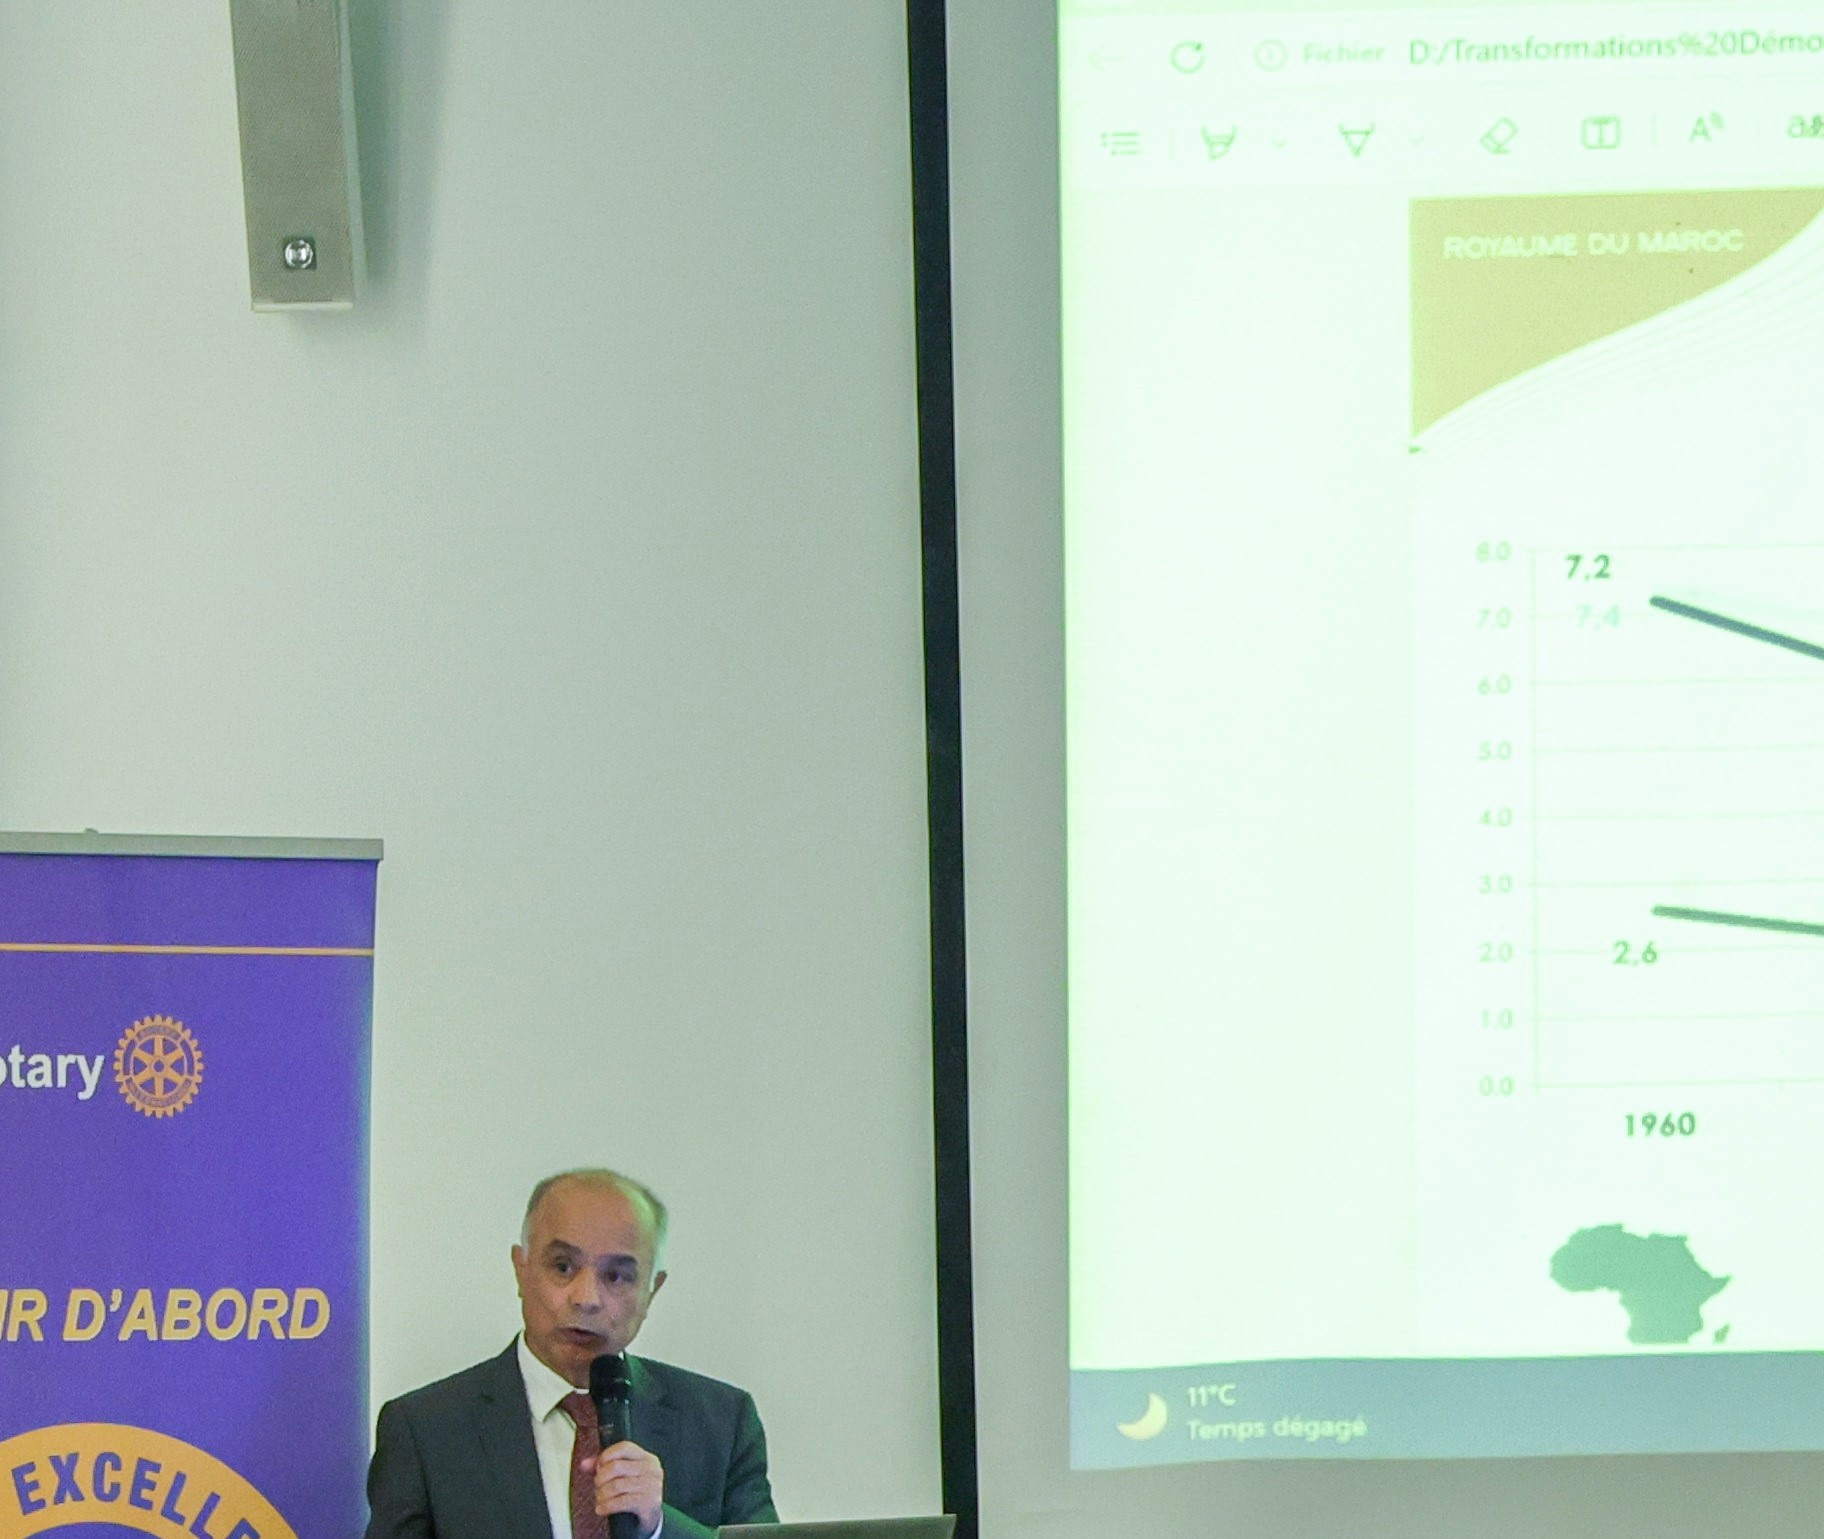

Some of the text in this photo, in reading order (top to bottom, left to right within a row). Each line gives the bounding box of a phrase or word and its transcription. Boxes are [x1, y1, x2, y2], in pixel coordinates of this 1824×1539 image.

[1303, 42, 1384, 64] Fichier
[1444, 228, 1744, 260] ROYAUME DU MAROC
[1625, 1110, 1698, 1138] 1960
[62, 1287, 330, 1342] D'ABORD
[1188, 1413, 1368, 1444] Temps dégagé
